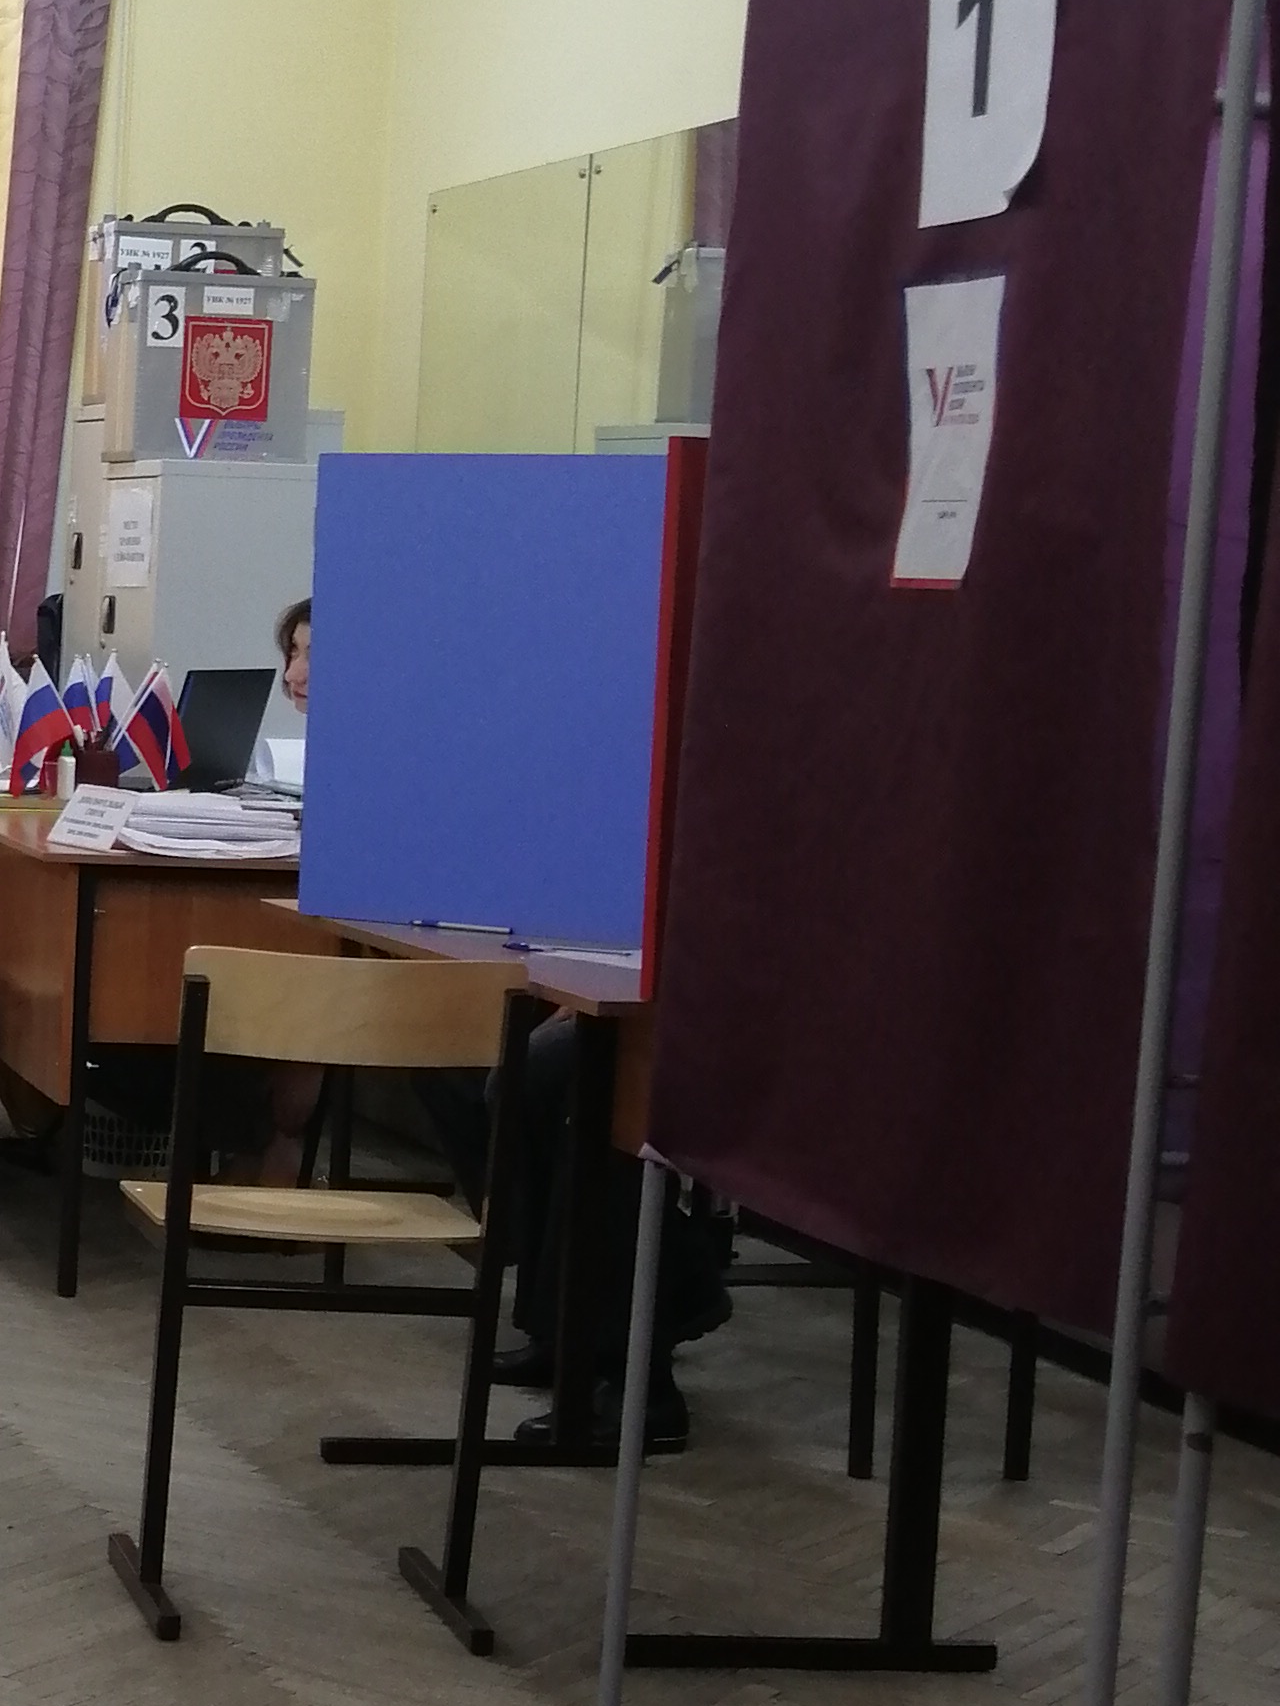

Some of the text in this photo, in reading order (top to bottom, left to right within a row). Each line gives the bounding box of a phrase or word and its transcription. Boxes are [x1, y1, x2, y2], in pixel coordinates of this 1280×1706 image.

[120, 247, 140, 258] УИК
[152, 250, 170, 260] 1927
[235, 296, 253, 305] 1927
[151, 294, 180, 341] 3
